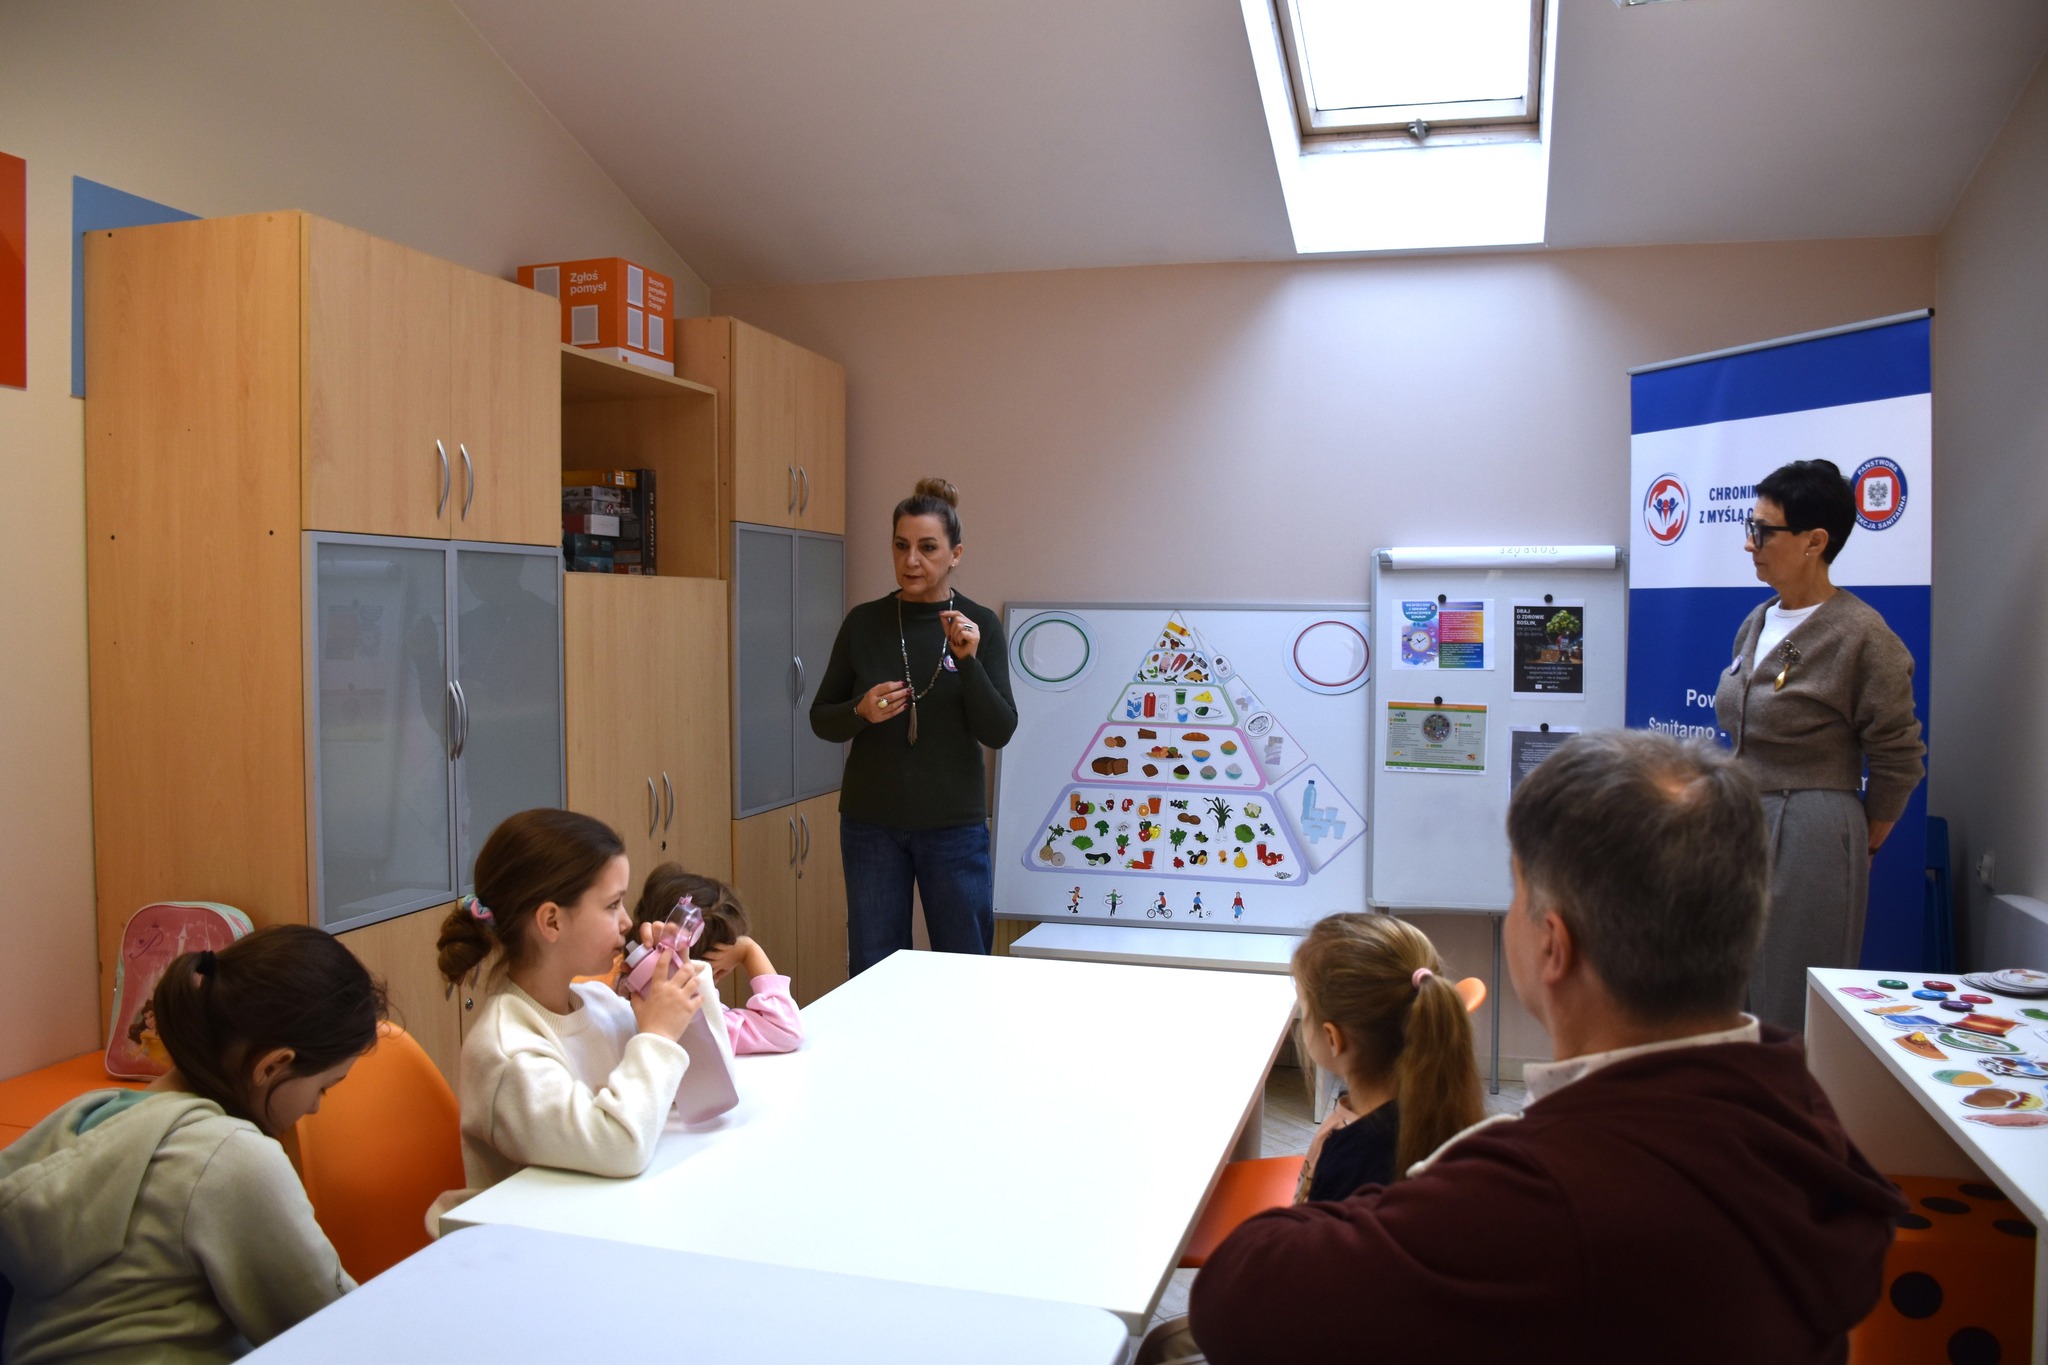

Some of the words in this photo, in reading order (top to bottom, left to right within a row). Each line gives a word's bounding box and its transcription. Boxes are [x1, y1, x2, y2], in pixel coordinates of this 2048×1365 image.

[570, 270, 598, 284] Zgłoś
[570, 281, 607, 296] pomysł
[1709, 485, 1758, 501] CHRONIM
[1699, 510, 1705, 524] Z
[1707, 505, 1744, 526] MYŚLĄ
[1856, 513, 1876, 530] EKCJA
[1877, 495, 1907, 530] SANITARNA
[1648, 716, 1715, 740] Sanitarno
